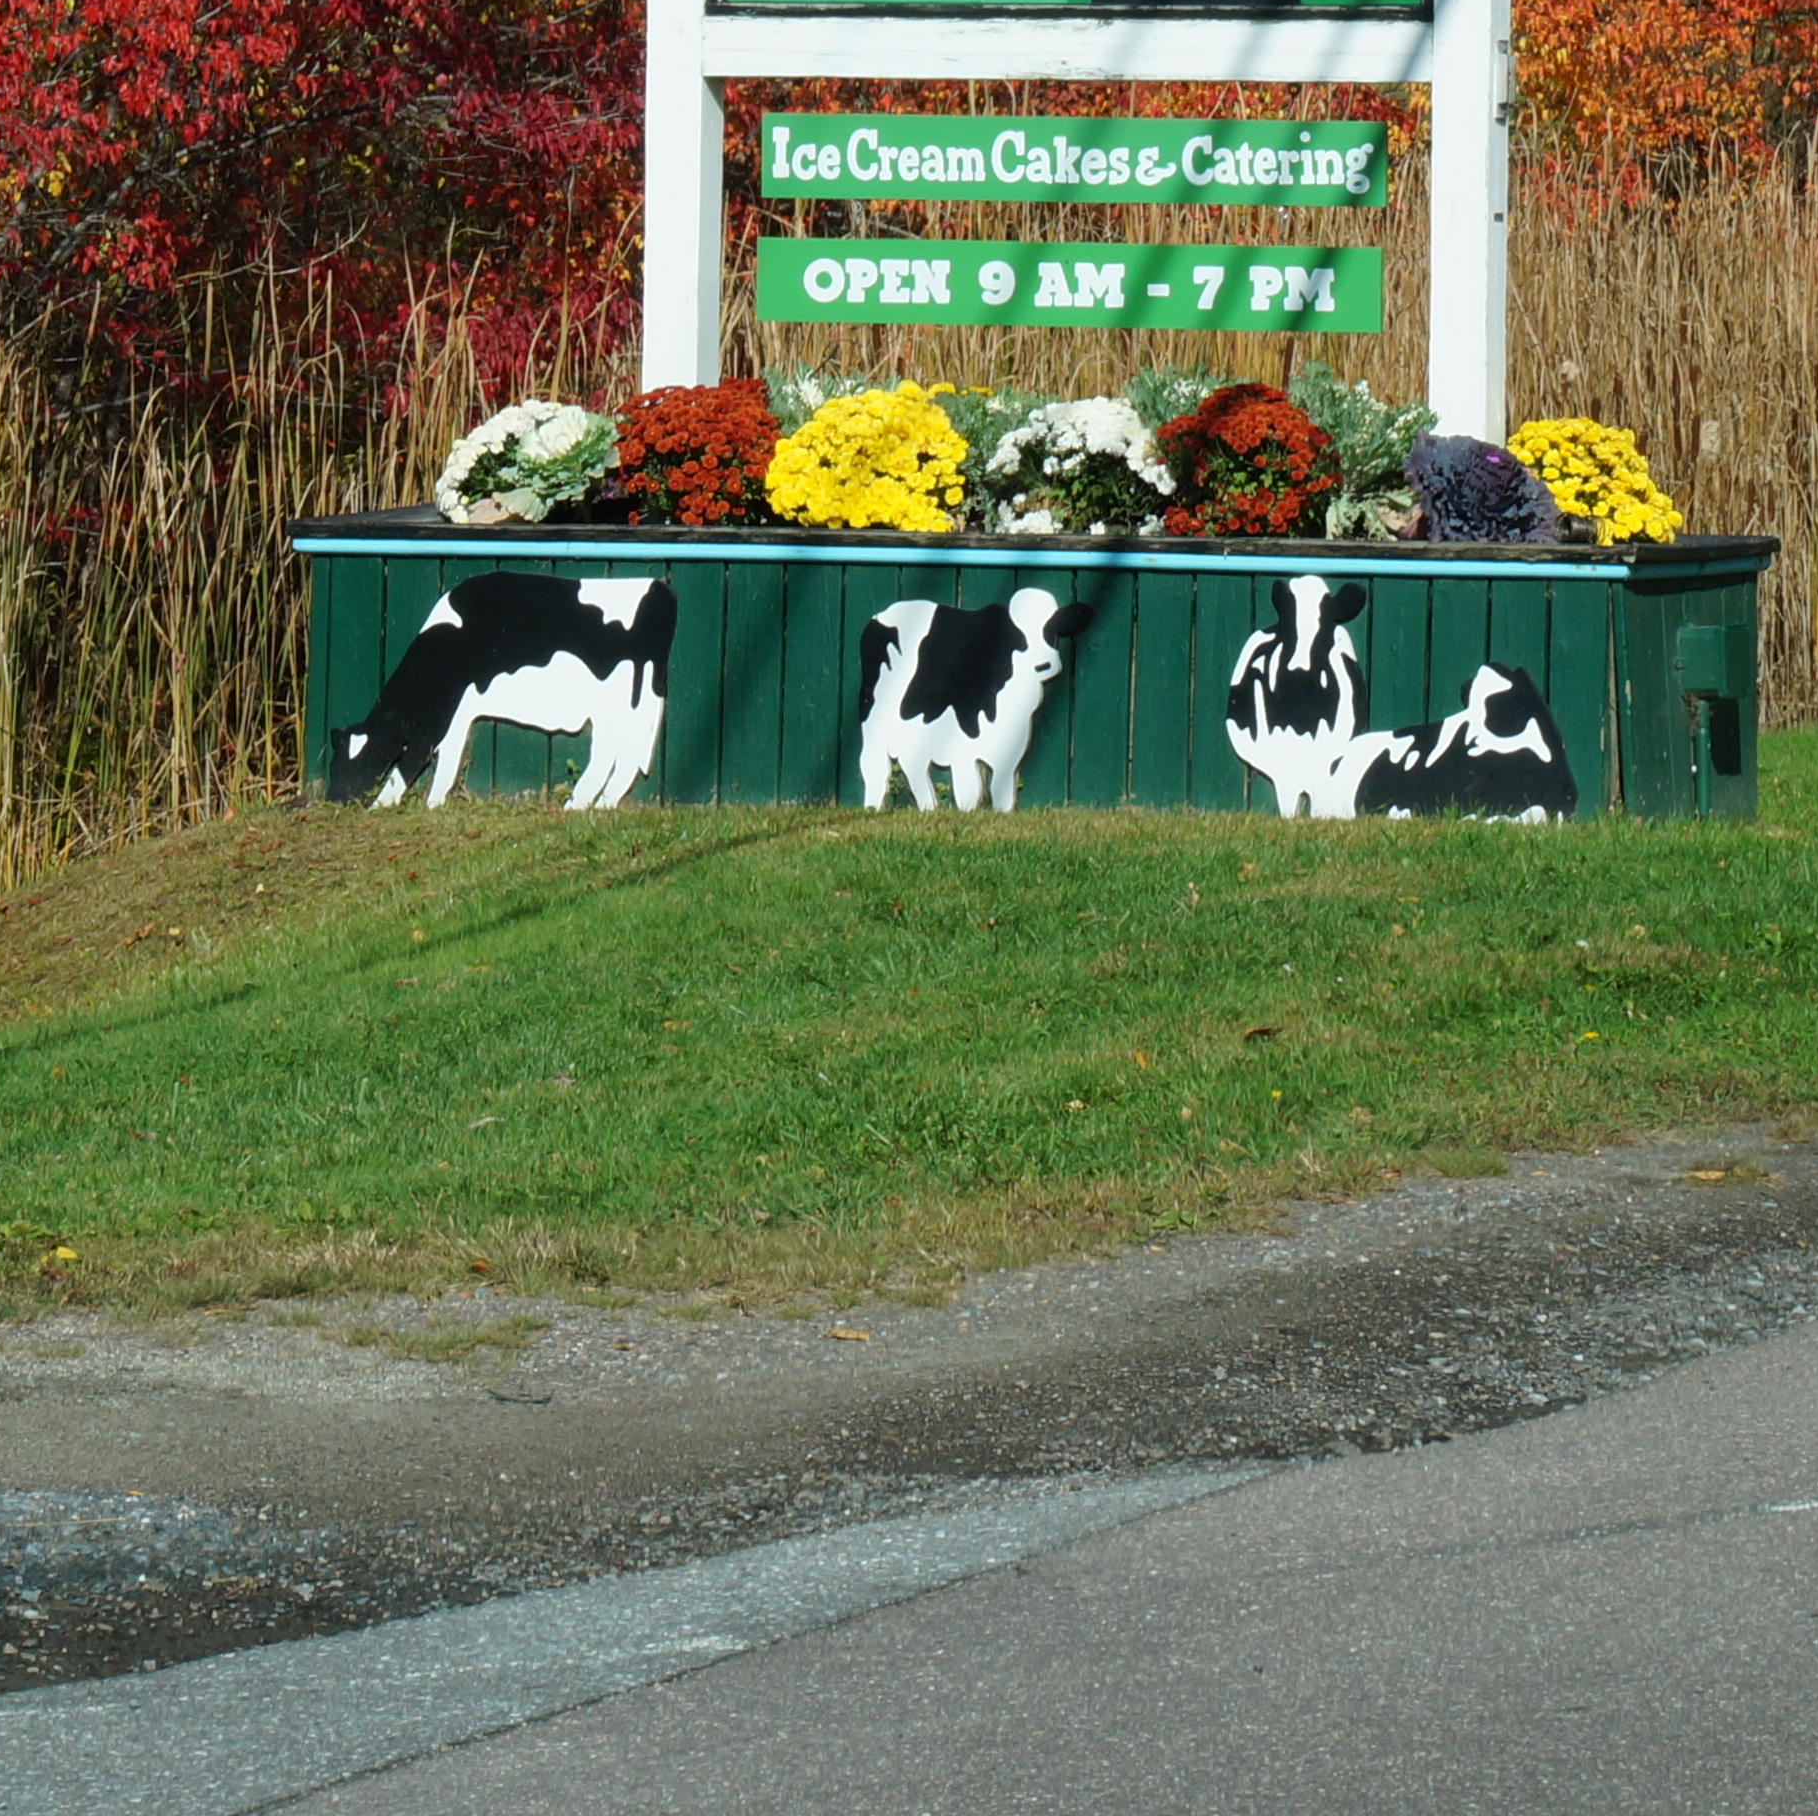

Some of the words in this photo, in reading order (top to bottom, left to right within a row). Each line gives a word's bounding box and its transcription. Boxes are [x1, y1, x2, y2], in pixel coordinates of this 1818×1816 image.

[771, 126, 841, 181] Ice
[846, 128, 986, 183] Cream
[990, 131, 1129, 185] Cakes
[1134, 145, 1177, 185] &
[1181, 132, 1374, 194] Catering
[803, 258, 951, 304] OPEN
[979, 260, 1017, 305] 9
[1034, 263, 1125, 308] AM
[1193, 266, 1224, 309] 7
[1250, 267, 1335, 311] PM
